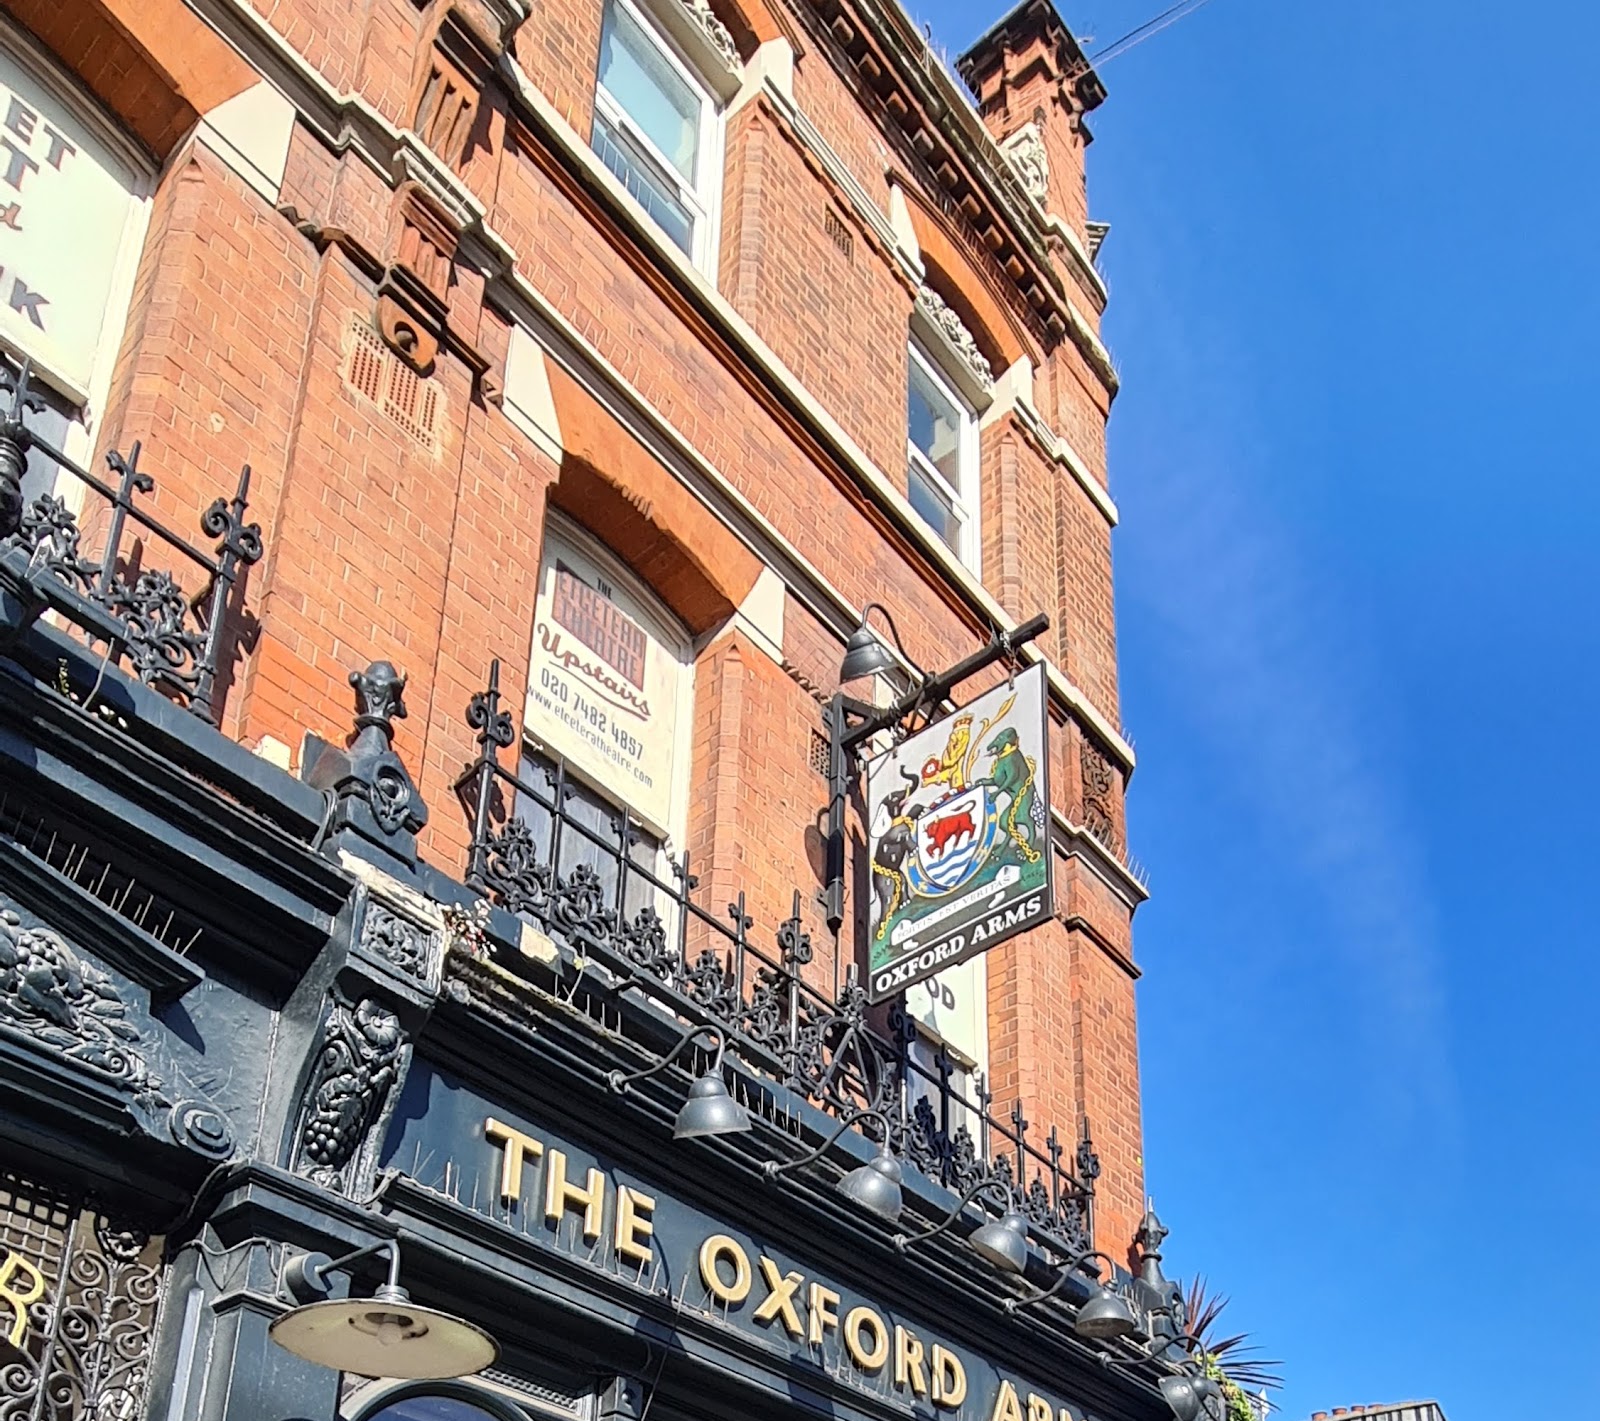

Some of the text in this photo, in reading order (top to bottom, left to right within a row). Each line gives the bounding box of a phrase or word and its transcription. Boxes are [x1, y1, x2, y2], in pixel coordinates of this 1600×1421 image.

[559, 573, 644, 658] ETCETERA
[597, 577, 612, 600] THE
[537, 622, 651, 716] Upstairs
[561, 598, 639, 681] THEATRE
[541, 667, 644, 761] 020 7482 4857
[875, 895, 1042, 995] OXFORD ARMS
[485, 1117, 656, 1263] THE
[700, 1233, 968, 1409] OXFORD
